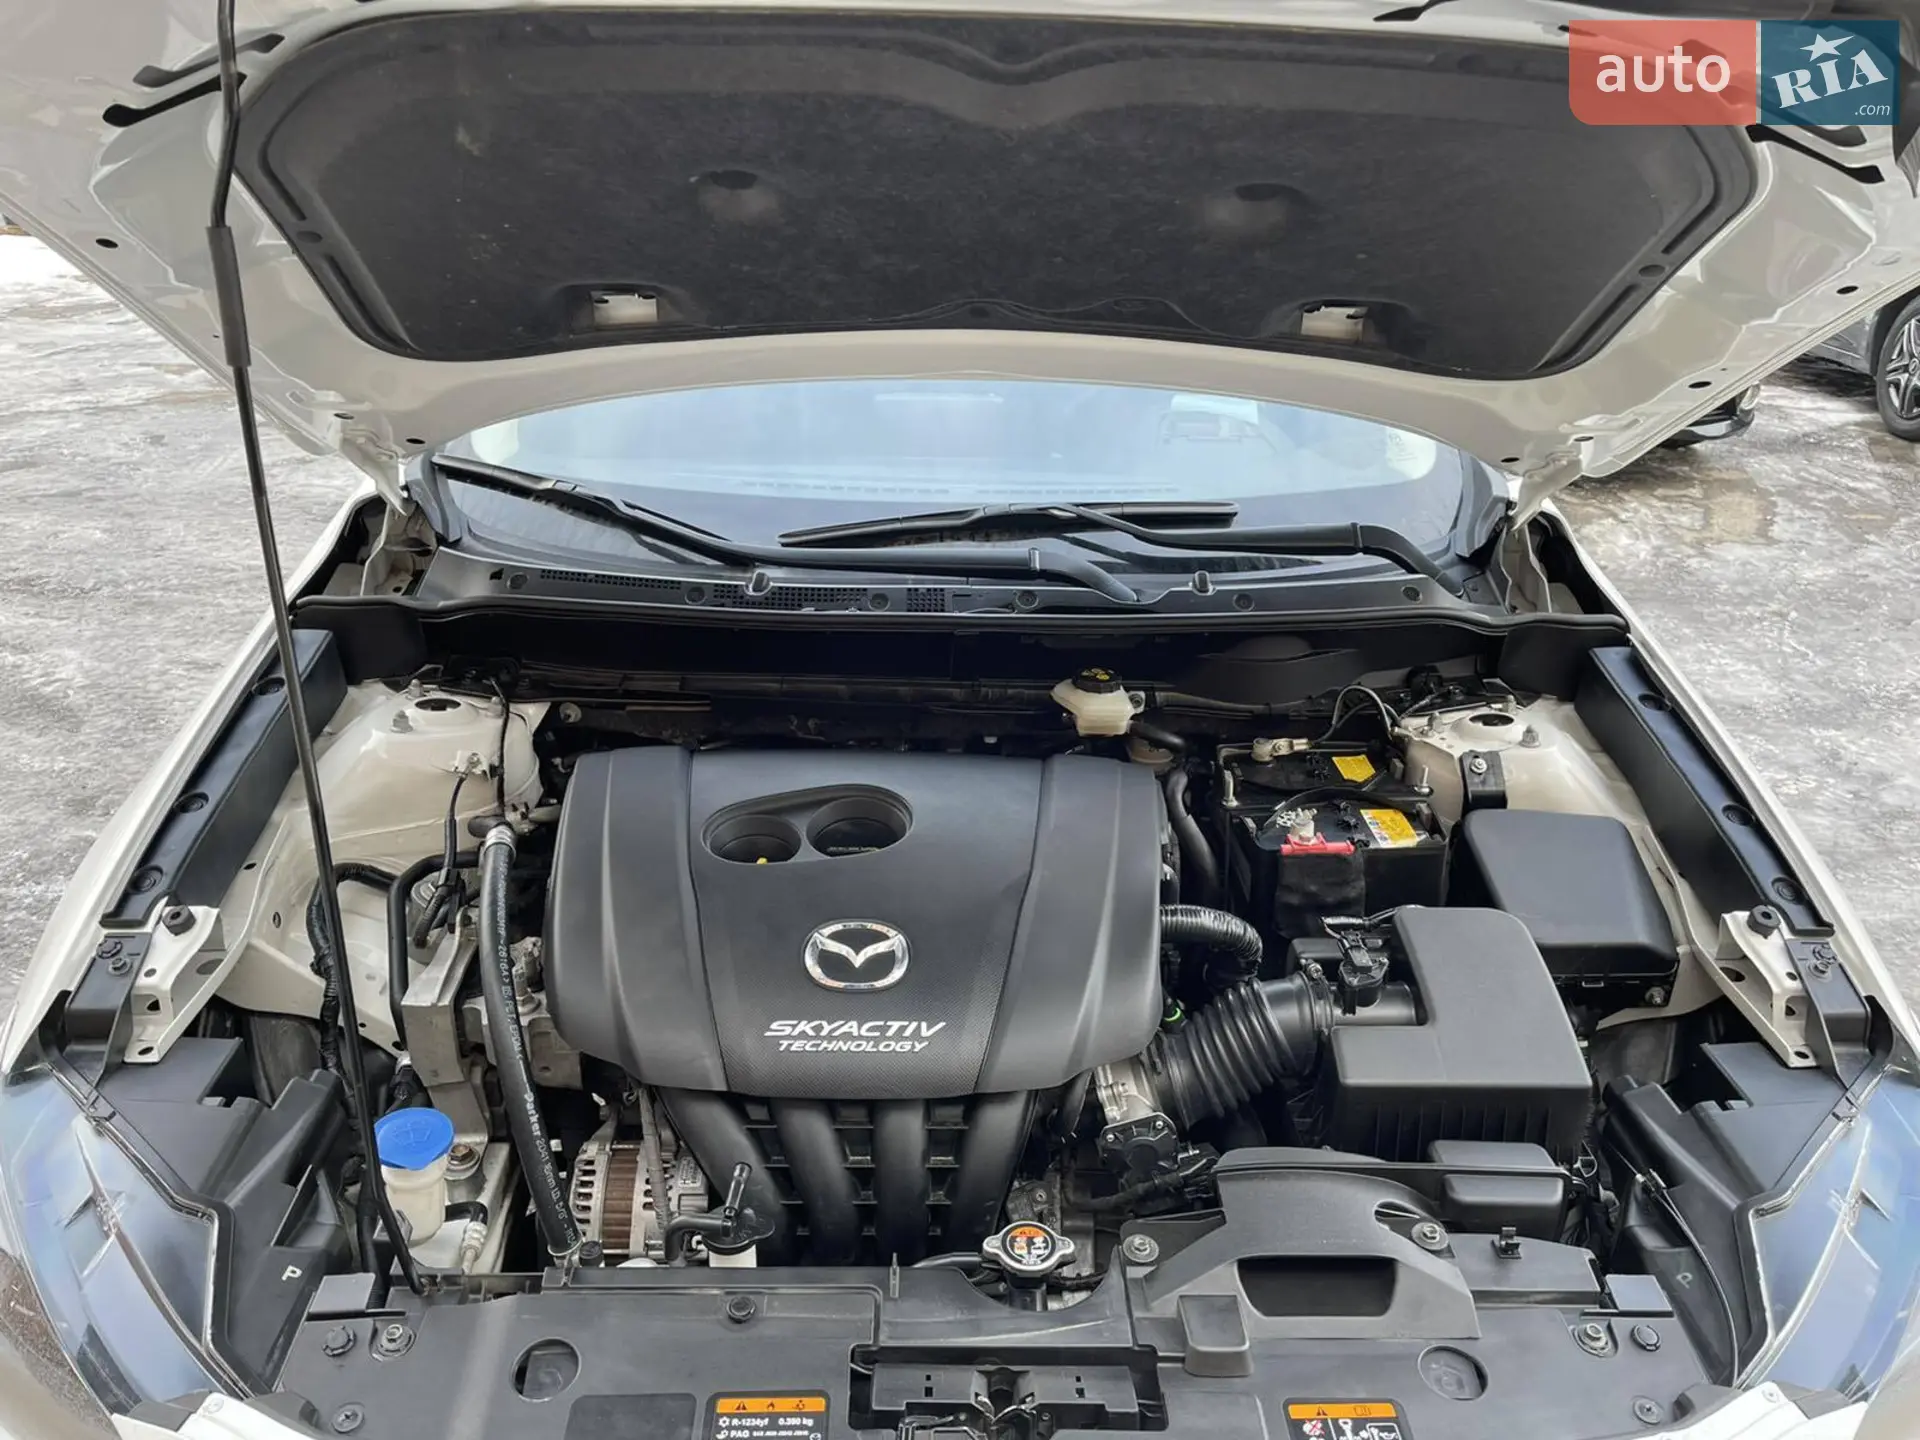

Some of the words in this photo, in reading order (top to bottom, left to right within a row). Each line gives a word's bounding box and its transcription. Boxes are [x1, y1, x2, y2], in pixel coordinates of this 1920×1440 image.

[764, 1020, 947, 1038] SKYACTIV
[778, 1040, 929, 1053] TECHNOLOGY
[524, 1091, 541, 1136] Parker
[281, 1264, 303, 1281] P
